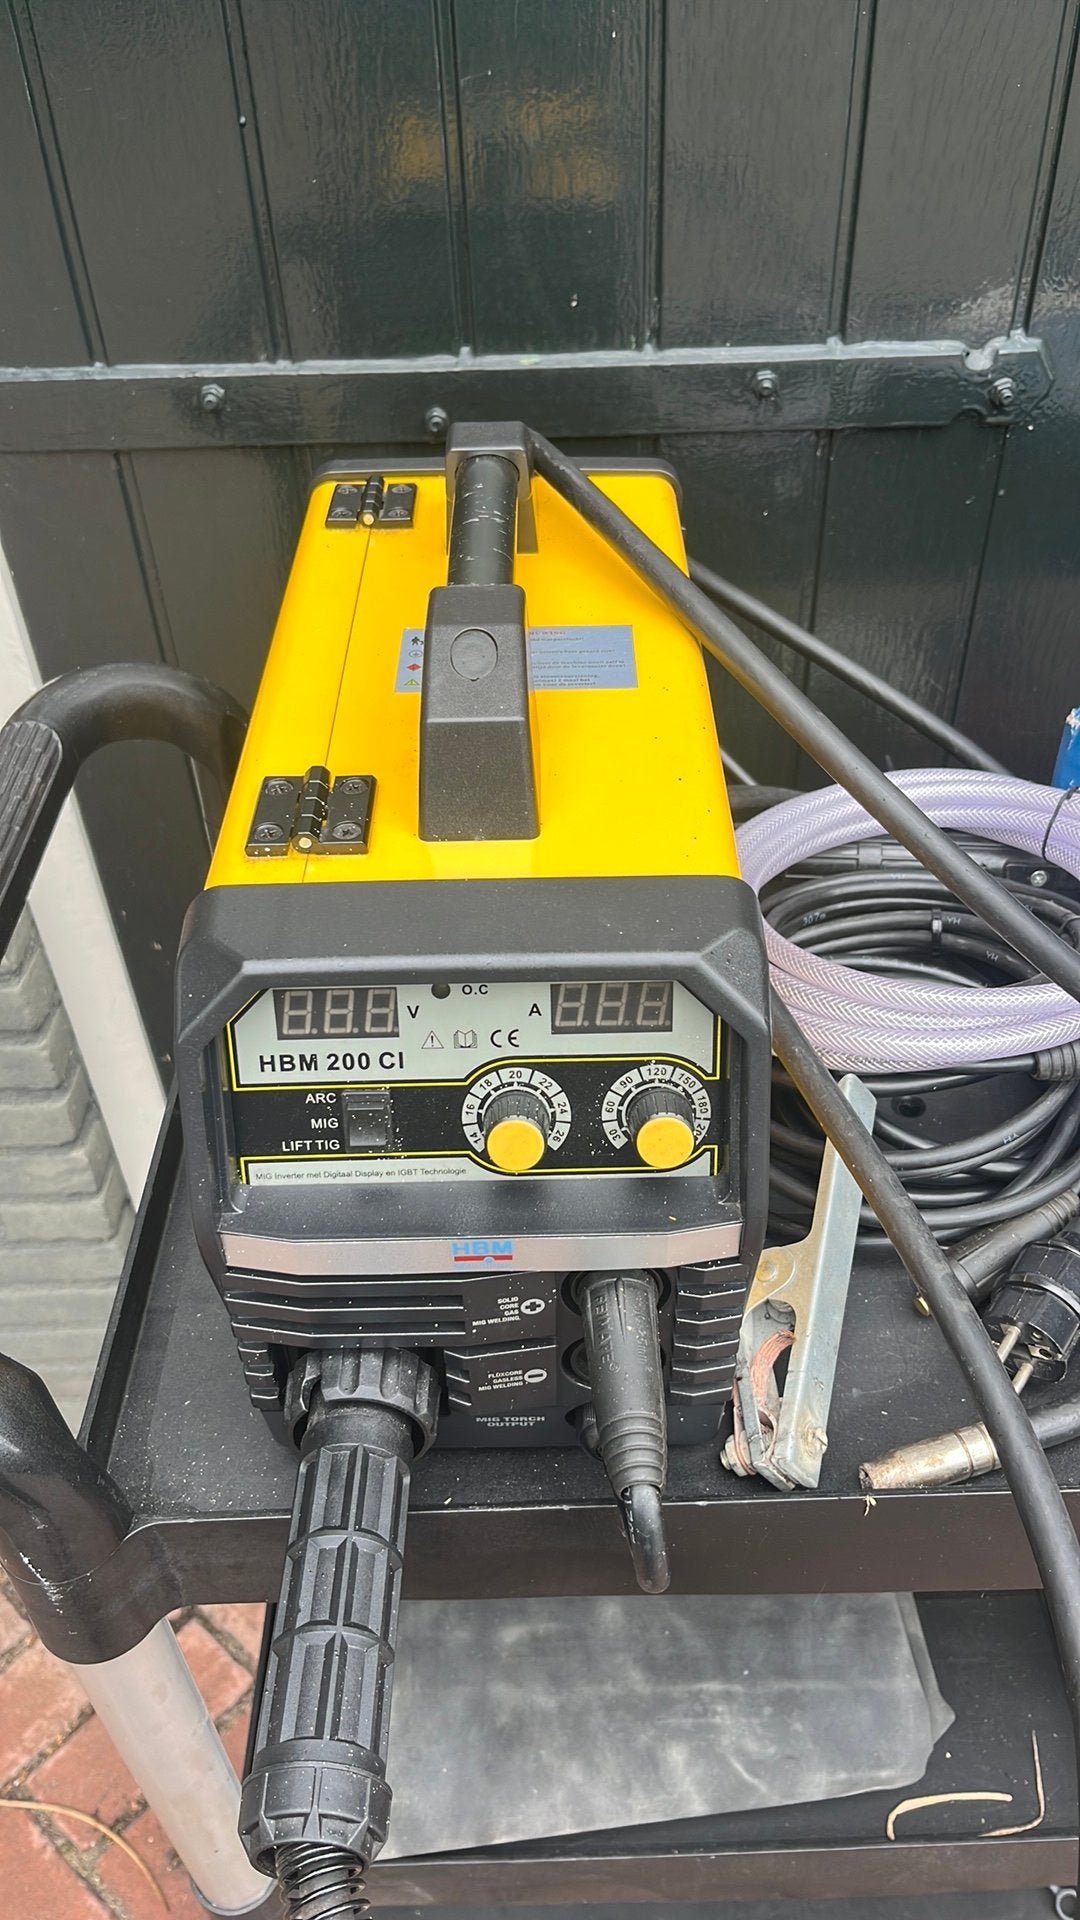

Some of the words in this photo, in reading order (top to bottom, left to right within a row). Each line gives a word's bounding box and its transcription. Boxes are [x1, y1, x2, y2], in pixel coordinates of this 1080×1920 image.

[406, 1005, 420, 1019] V
[528, 1003, 543, 1017] A
[258, 1053, 319, 1073] HBM
[326, 1052, 371, 1071] 200
[378, 1051, 404, 1070] CI
[508, 1069, 523, 1080] 20
[647, 1066, 667, 1077] 120
[479, 1078, 493, 1092] 18
[538, 1077, 554, 1091] 22
[619, 1075, 634, 1088] 90
[677, 1072, 697, 1089] 150
[305, 1092, 337, 1104] ARC
[697, 1096, 709, 1114] 180
[465, 1103, 475, 1117] 16
[556, 1101, 567, 1115] 24
[605, 1099, 615, 1114] 60
[310, 1117, 339, 1129] MIG
[467, 1131, 483, 1144] 14
[552, 1128, 566, 1143] 26
[608, 1128, 622, 1142] 30
[694, 1123, 706, 1140] 20
[281, 1140, 313, 1152] LIFT
[316, 1139, 341, 1151] TIG
[255, 1172, 273, 1181] MIG
[274, 1171, 304, 1180] Inverter
[323, 1169, 353, 1179] Digitaal
[354, 1169, 383, 1179] Display
[419, 1167, 467, 1177] Technologie
[451, 1240, 513, 1255] HBM
[497, 1296, 519, 1304] SOLID
[499, 1302, 519, 1310] CORE
[471, 1319, 487, 1327] MIG
[487, 1369, 523, 1379] FLUXCORE
[492, 1375, 524, 1384] GASLESS
[492, 1381, 524, 1390] WELDING
